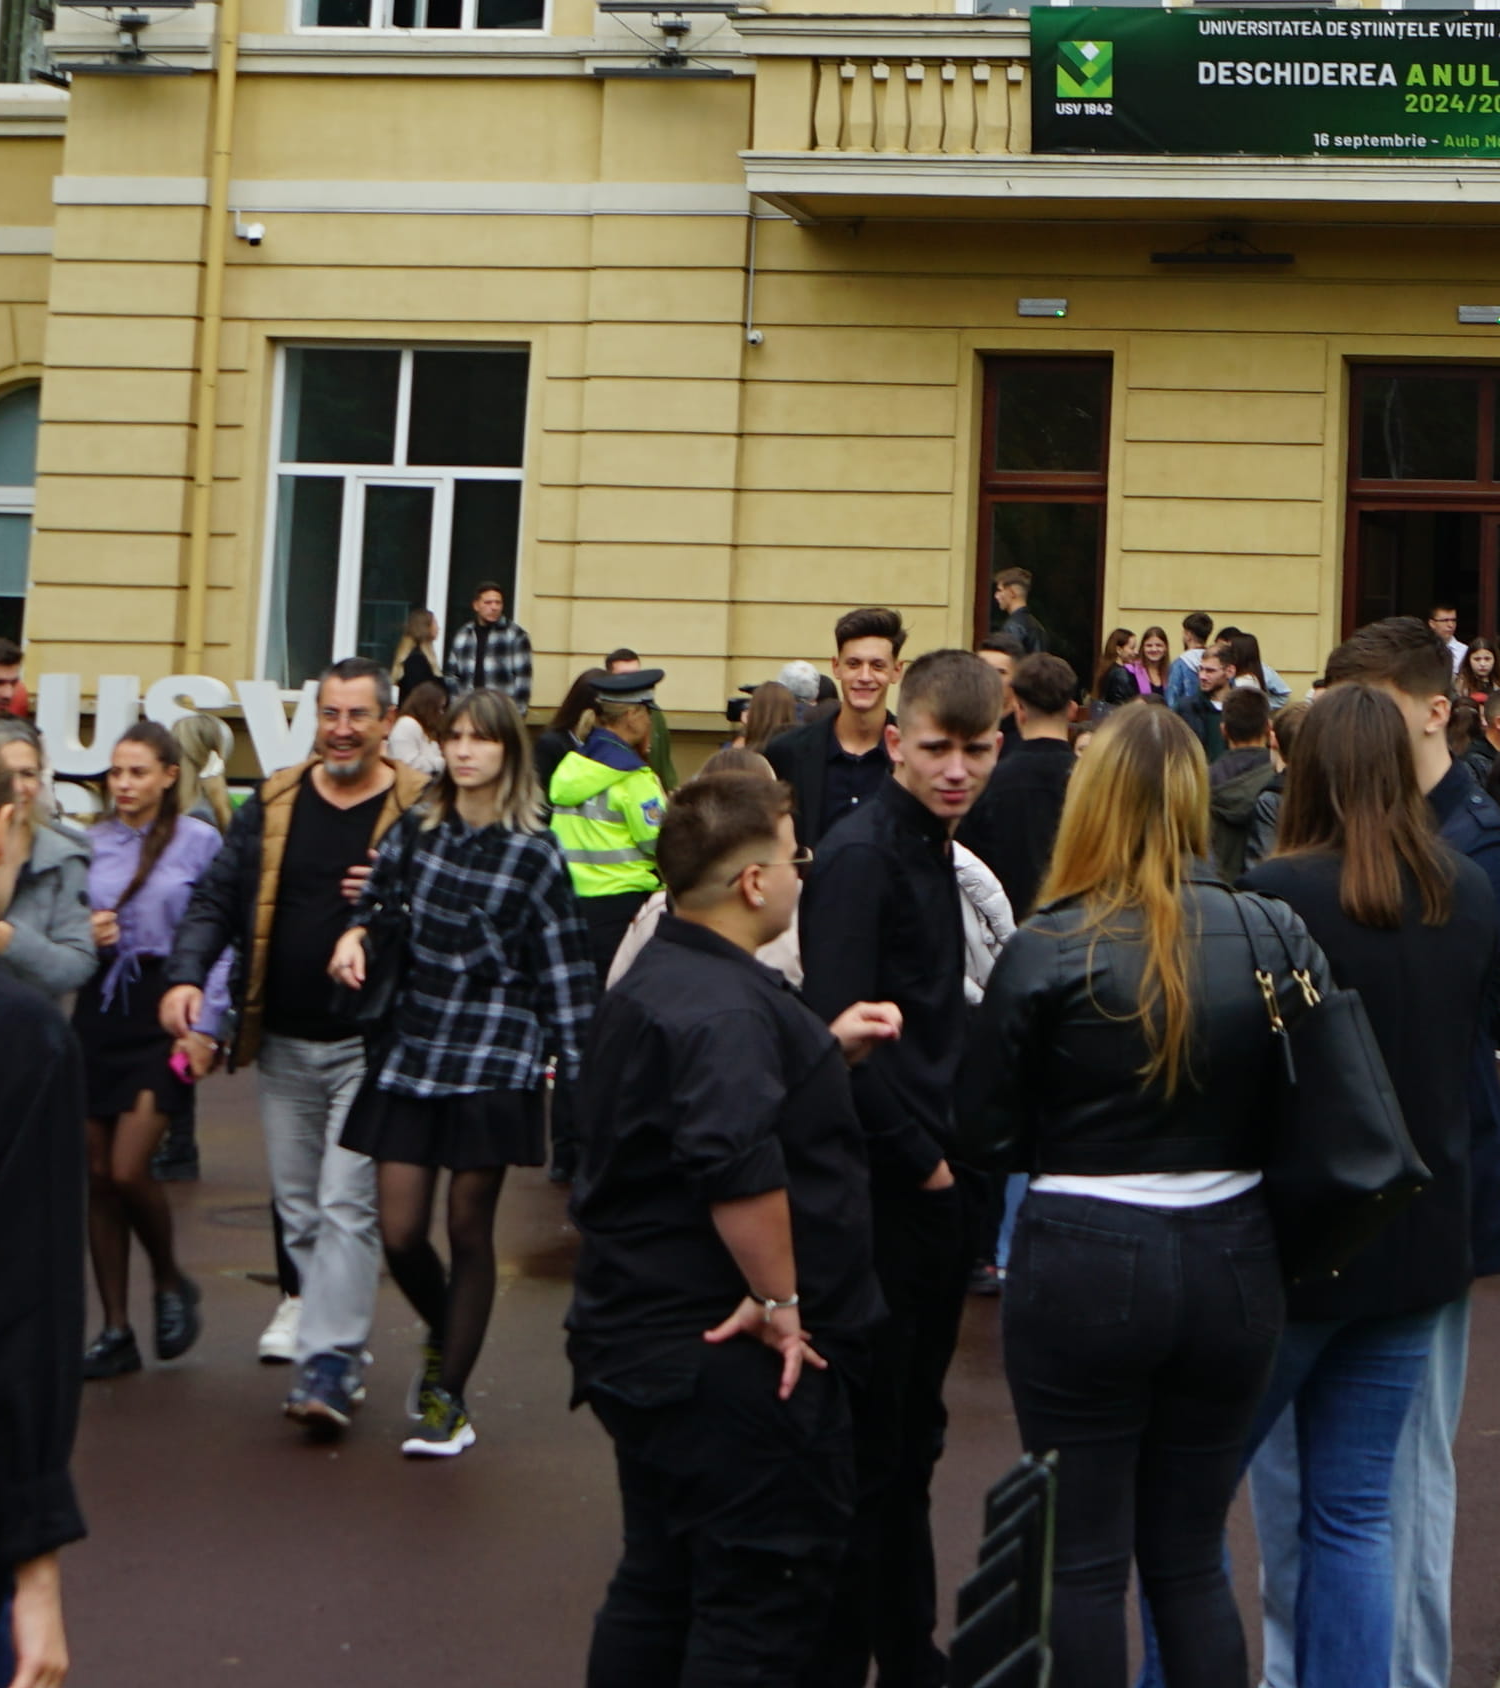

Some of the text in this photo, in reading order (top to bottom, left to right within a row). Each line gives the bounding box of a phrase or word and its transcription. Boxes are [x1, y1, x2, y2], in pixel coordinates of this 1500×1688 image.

[1199, 20, 1324, 37] UNIVERSITATEA
[1326, 21, 1348, 37] DE
[1350, 21, 1440, 40] ȘTIINȚELE
[1446, 22, 1495, 40] VIEȚII
[1198, 61, 1398, 87] DESCHIDEREA
[1055, 102, 1114, 116] USV 1842
[1313, 133, 1330, 148] 16
[1334, 133, 1427, 150] septembrie
[1444, 133, 1479, 148] Aula
